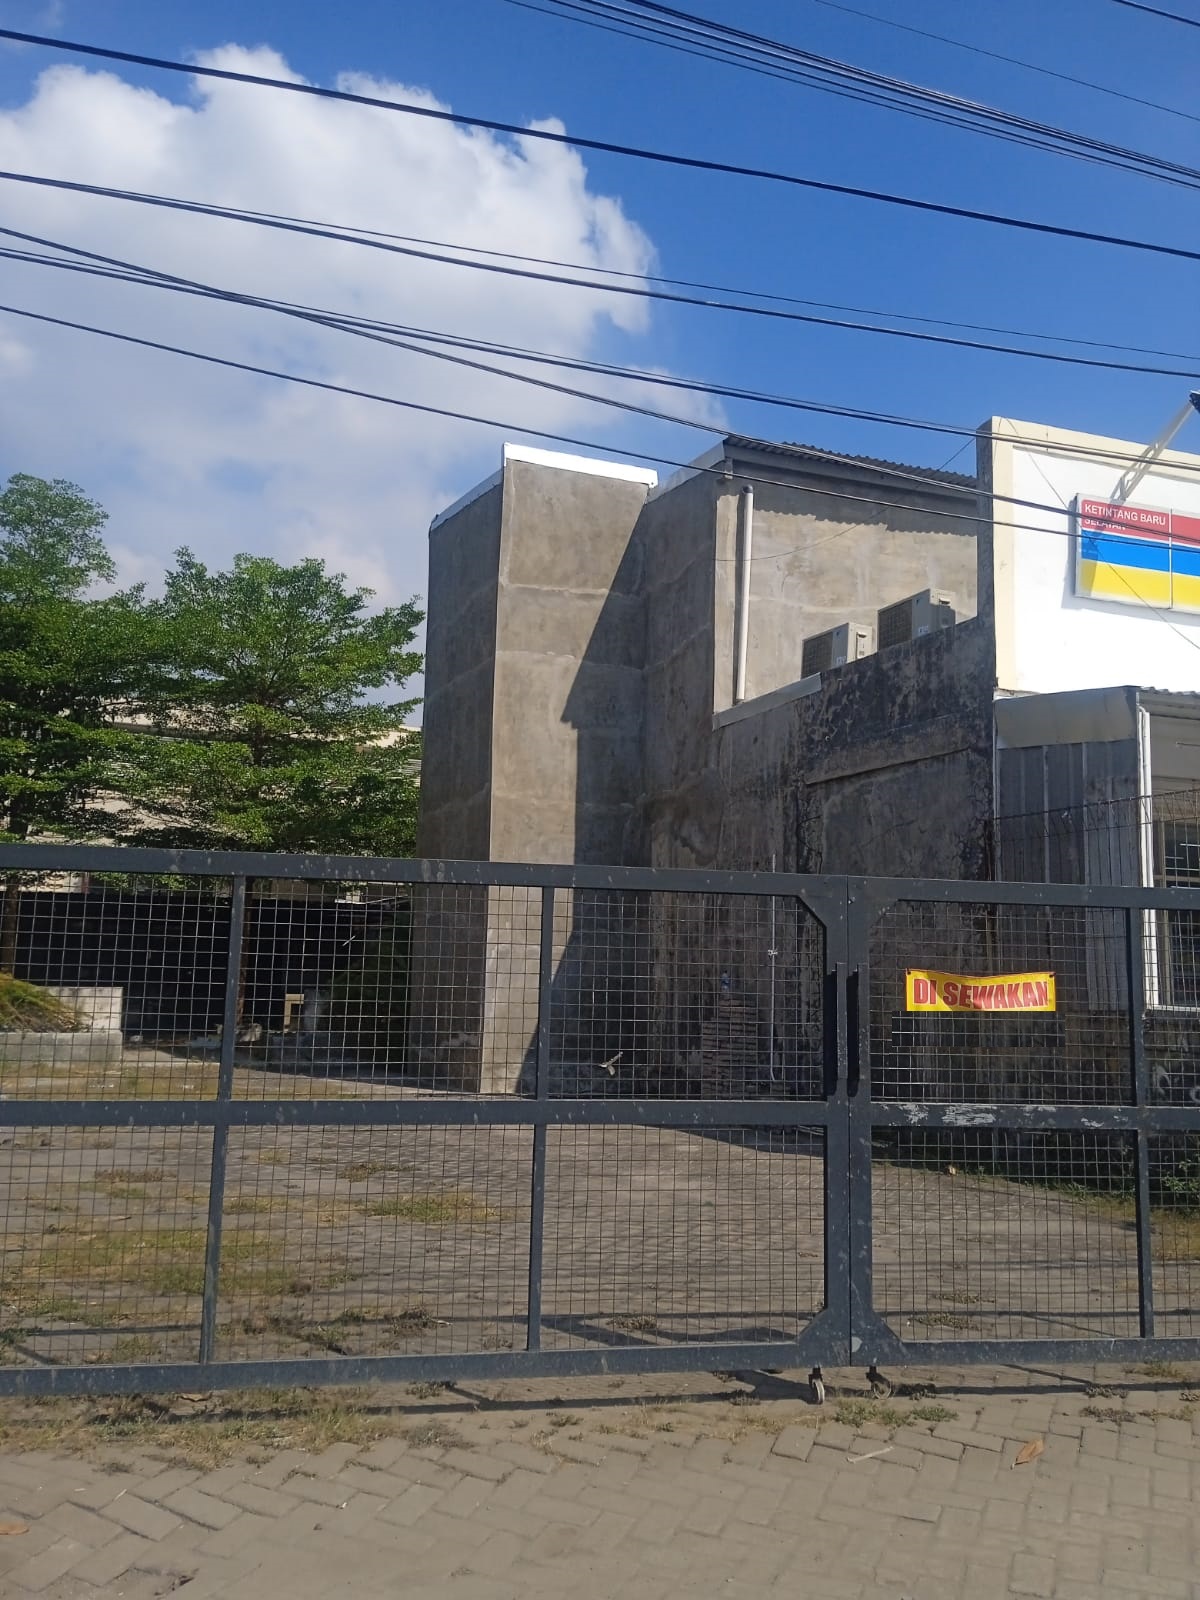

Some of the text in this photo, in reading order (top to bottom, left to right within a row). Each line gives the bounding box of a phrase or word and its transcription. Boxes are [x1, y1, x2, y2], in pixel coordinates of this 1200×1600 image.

[1085, 504, 1166, 526] KETINTANG BARU
[913, 978, 1048, 1010] DI SEWAKAN
